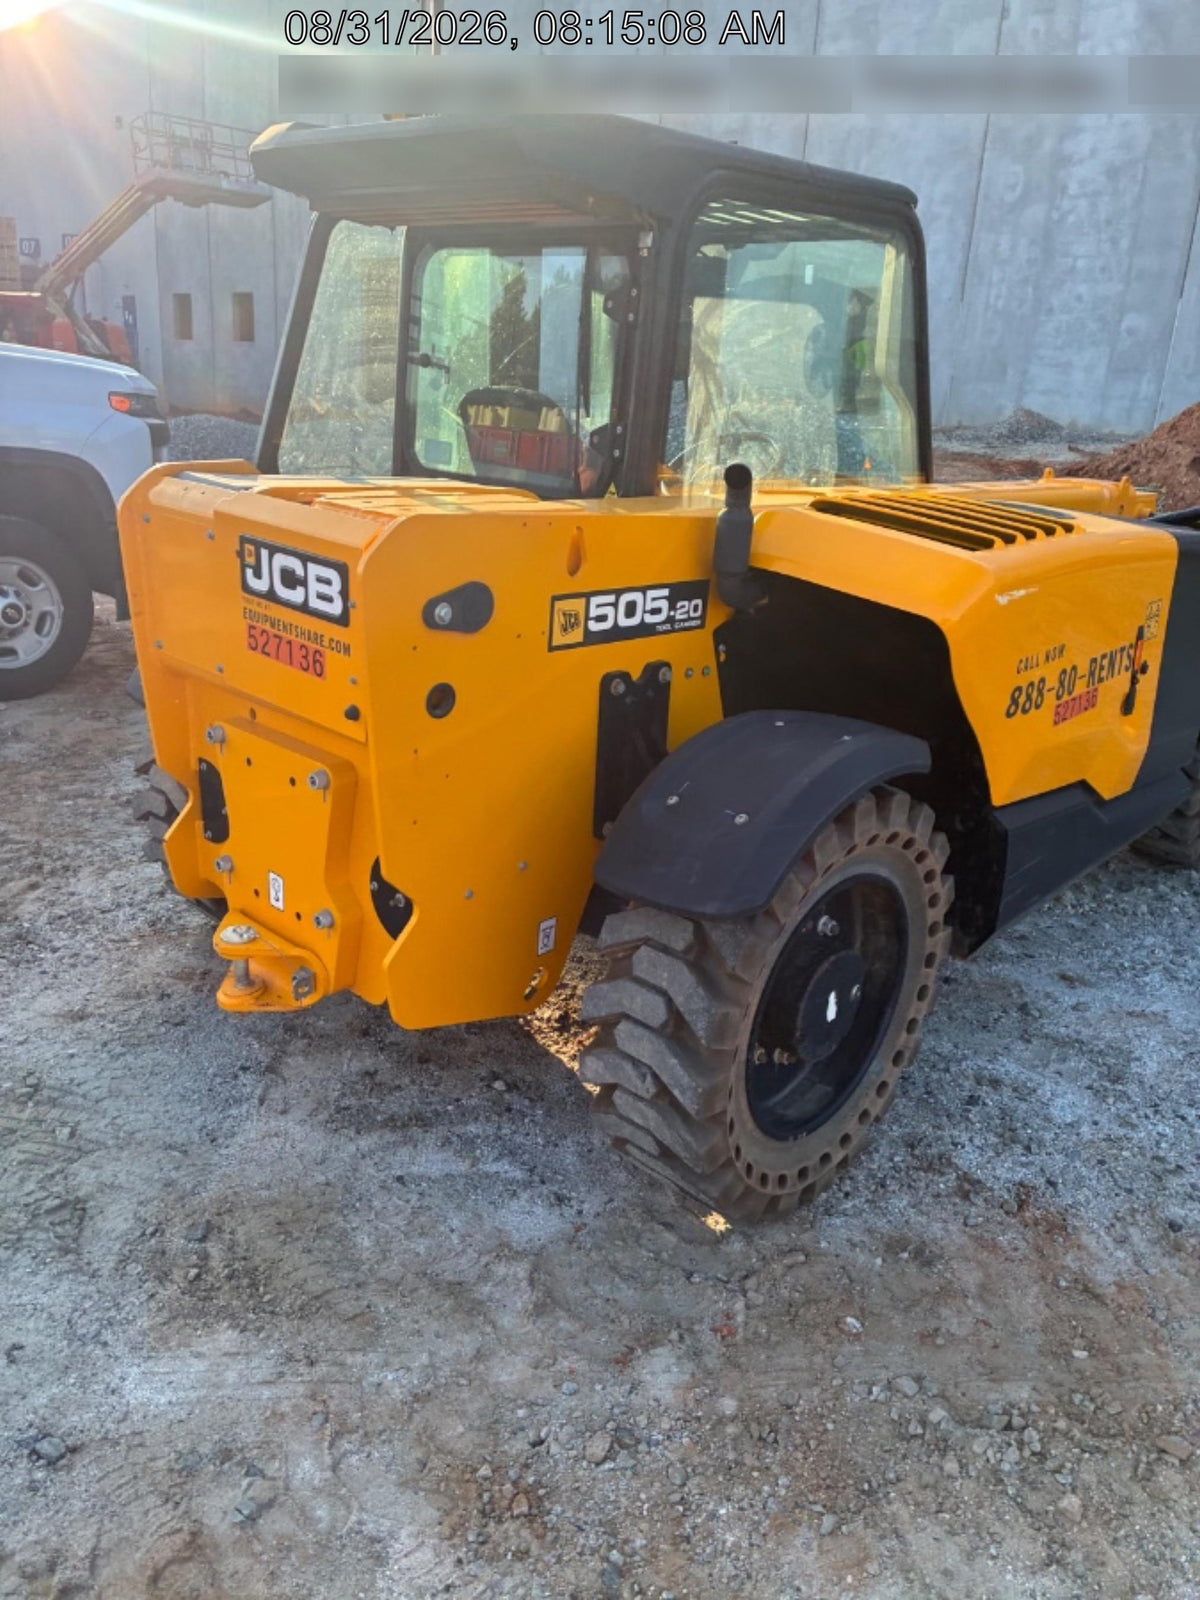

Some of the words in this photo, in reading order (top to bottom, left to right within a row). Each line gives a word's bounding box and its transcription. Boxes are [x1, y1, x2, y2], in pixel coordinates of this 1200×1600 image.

[245, 547, 344, 618] JCB
[243, 606, 351, 657] EQUIPMENTSHARE.COM
[248, 624, 325, 678] 527136
[1005, 642, 1135, 719] 888-80-RENTS
[1016, 652, 1040, 675] CALL
[1044, 643, 1067, 664] NOW
[1053, 688, 1099, 726] 527136
